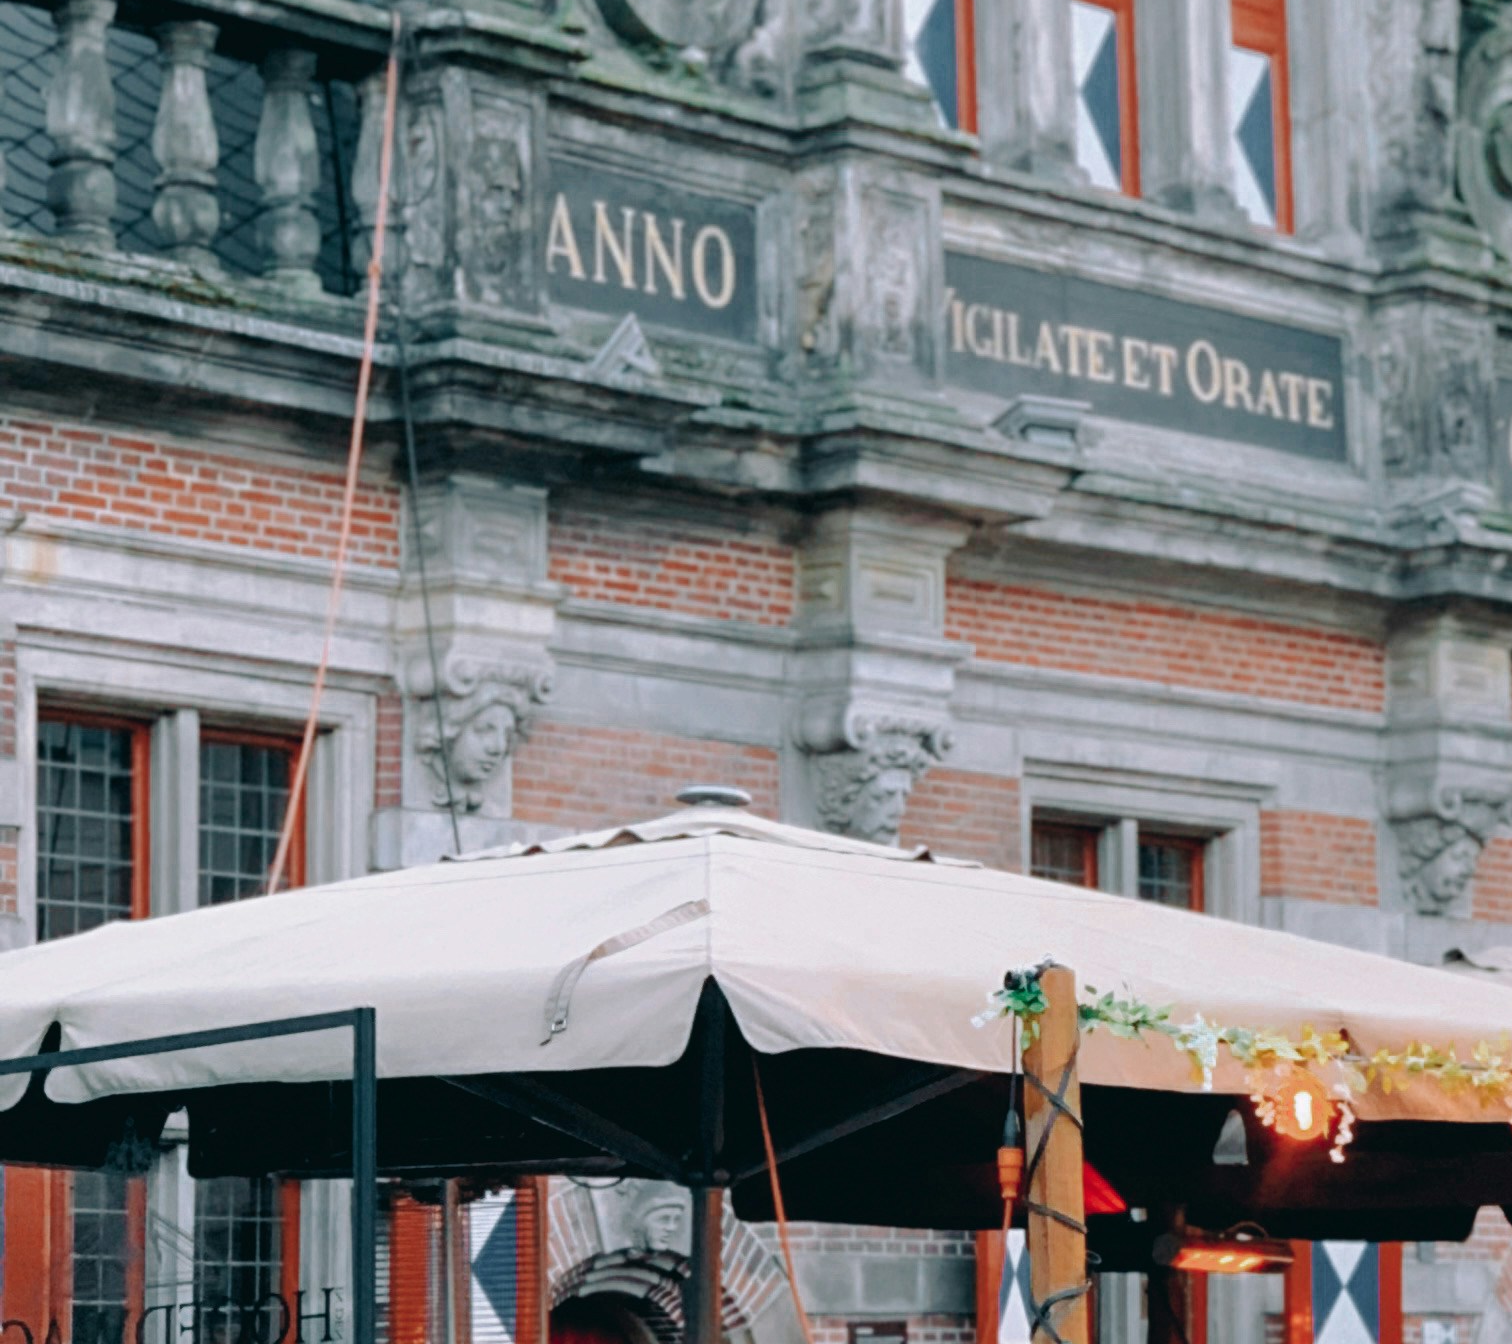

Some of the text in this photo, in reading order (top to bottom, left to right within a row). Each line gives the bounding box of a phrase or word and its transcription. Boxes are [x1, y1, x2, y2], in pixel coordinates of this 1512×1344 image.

[546, 192, 736, 308] ANNO
[944, 287, 1116, 384] IGILATE
[1122, 336, 1178, 397] ET
